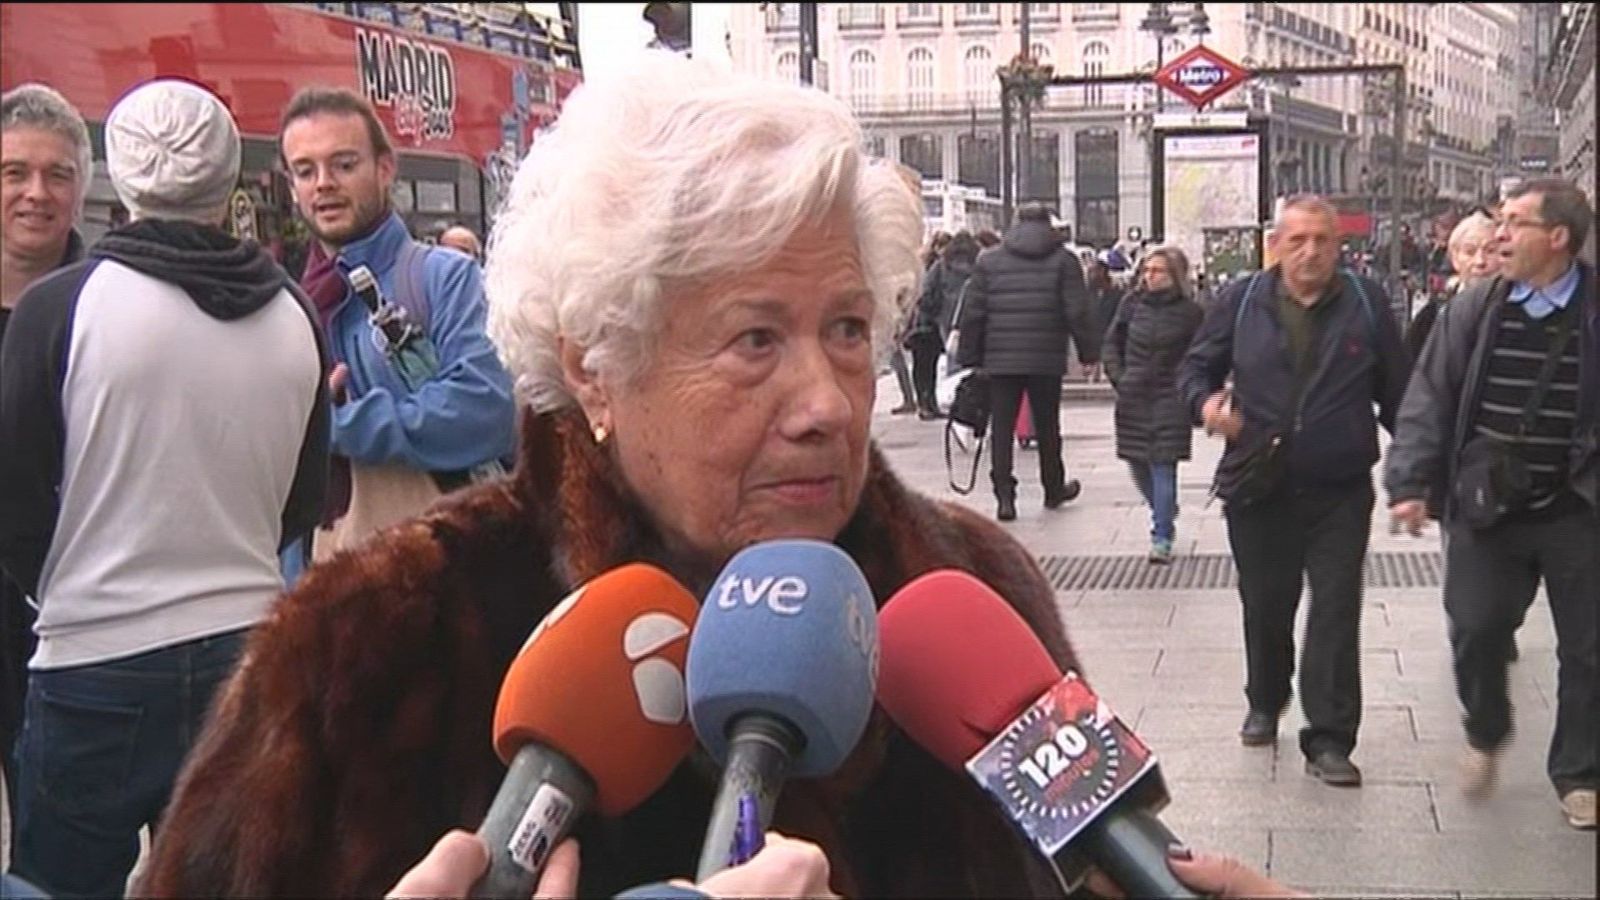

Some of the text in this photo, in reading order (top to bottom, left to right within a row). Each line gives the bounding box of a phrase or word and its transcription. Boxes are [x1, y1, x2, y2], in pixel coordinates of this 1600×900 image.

[356, 28, 456, 113] MADRID
[1180, 66, 1221, 84] Metro
[718, 573, 808, 615] tve
[1017, 724, 1089, 789] 120
